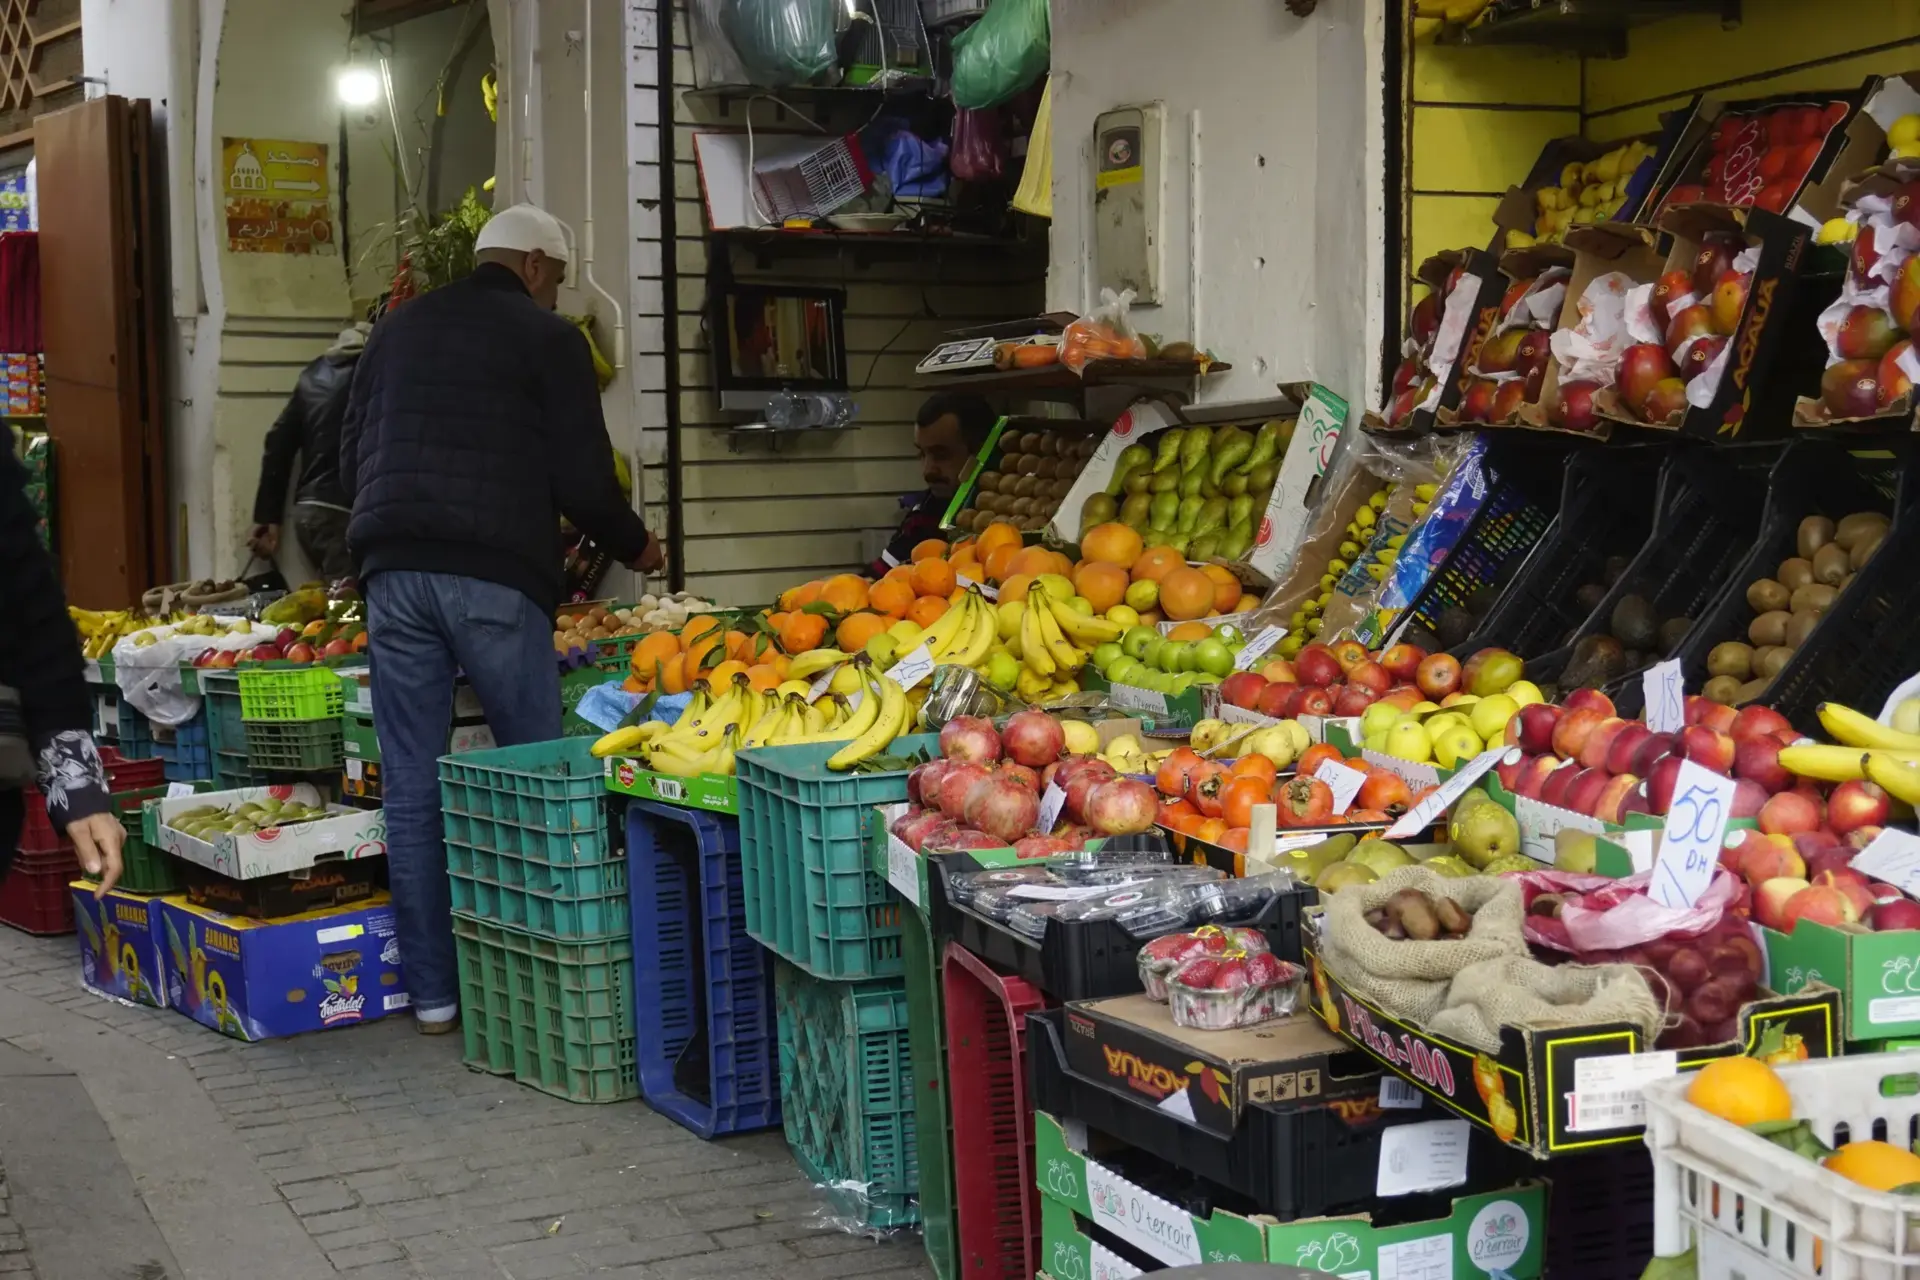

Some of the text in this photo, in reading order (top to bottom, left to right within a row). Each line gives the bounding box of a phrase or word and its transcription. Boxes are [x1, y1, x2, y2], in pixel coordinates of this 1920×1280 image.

[266, 150, 319, 169] مسجد
[661, 781, 678, 798] KIWI
[1668, 784, 1721, 843] 50
[1686, 849, 1708, 873] DH
[115, 903, 148, 925] BANANAS
[205, 926, 240, 954] BANANAS
[1340, 992, 1456, 1097] Pika-100
[1130, 1196, 1193, 1250] O'terroir
